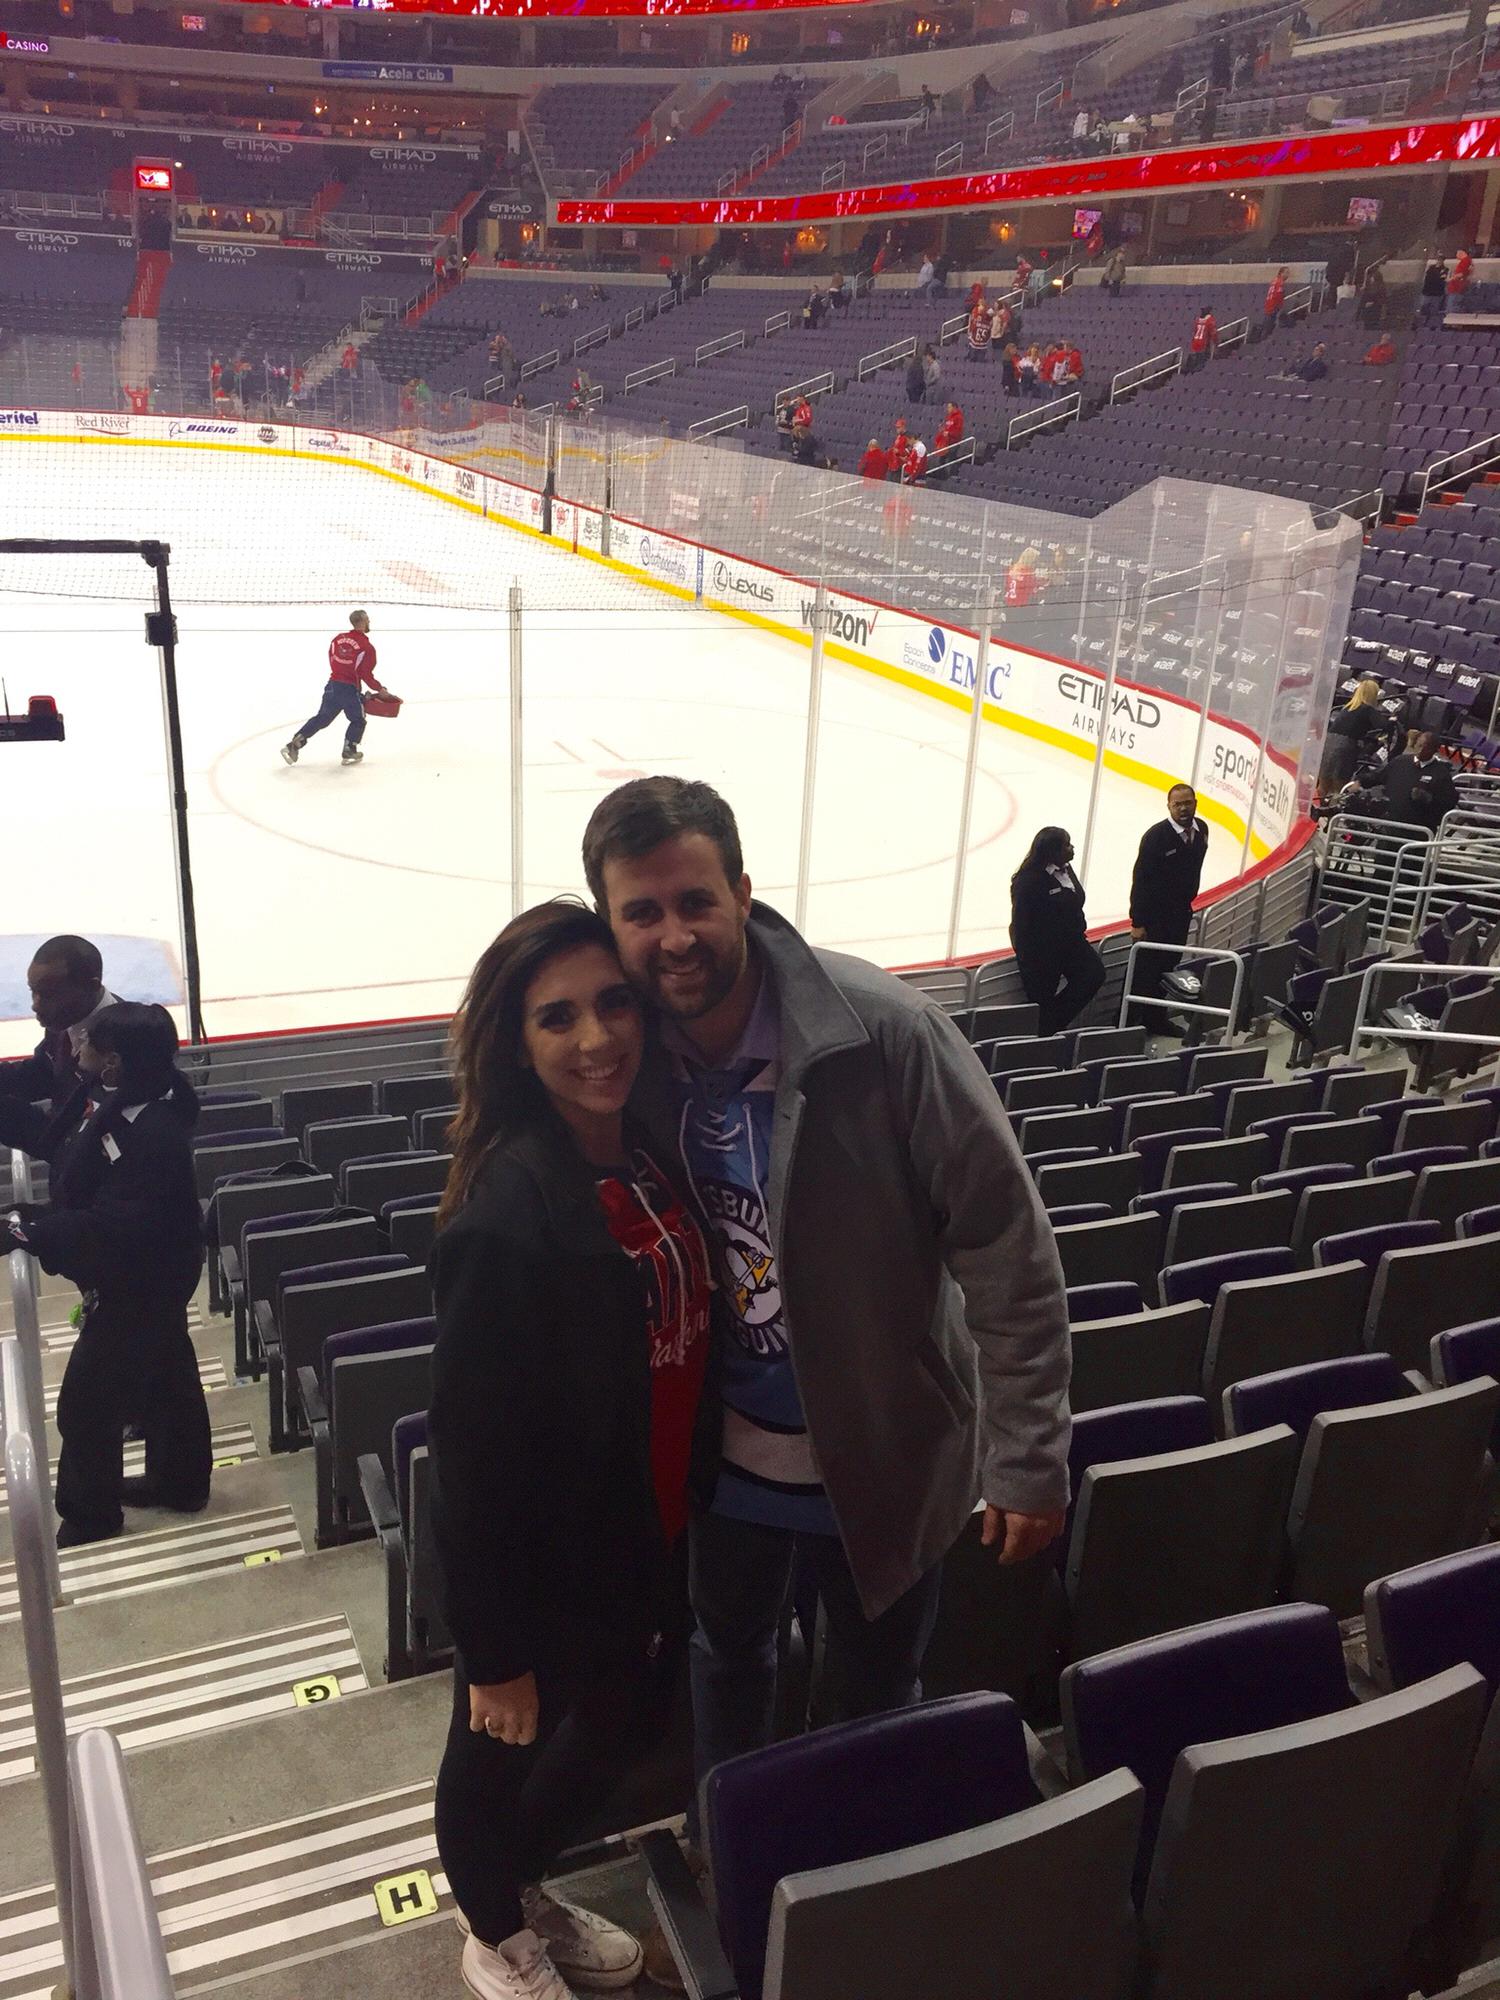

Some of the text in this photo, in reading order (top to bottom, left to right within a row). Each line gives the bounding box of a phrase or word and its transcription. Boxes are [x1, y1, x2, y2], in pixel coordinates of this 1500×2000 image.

[6, 40, 48, 52] CASINO
[416, 69, 445, 81] Club
[0, 119, 75, 136] ETIHAD
[222, 138, 293, 153] ETIHAD
[369, 148, 437, 162] ETIHAD
[488, 203, 532, 214] ETIHAD
[15, 231, 79, 245] ETIHAD
[118, 239, 133, 248] 116
[27, 244, 69, 253] AIRWAYS
[197, 244, 257, 257] ETIHAD
[208, 256, 247, 265] AIRWAYS
[325, 252, 382, 265] ETIHAD
[336, 264, 373, 272] AIRWAYS
[75, 415, 130, 429] Red River
[186, 424, 238, 434] BOEING
[728, 571, 774, 601] LEXUS
[800, 600, 868, 647] veizon
[903, 642, 925, 658] Epoch
[902, 653, 937, 675] Concepts
[1058, 673, 1161, 728] ETIHAD
[389, 1881, 423, 1915] H
